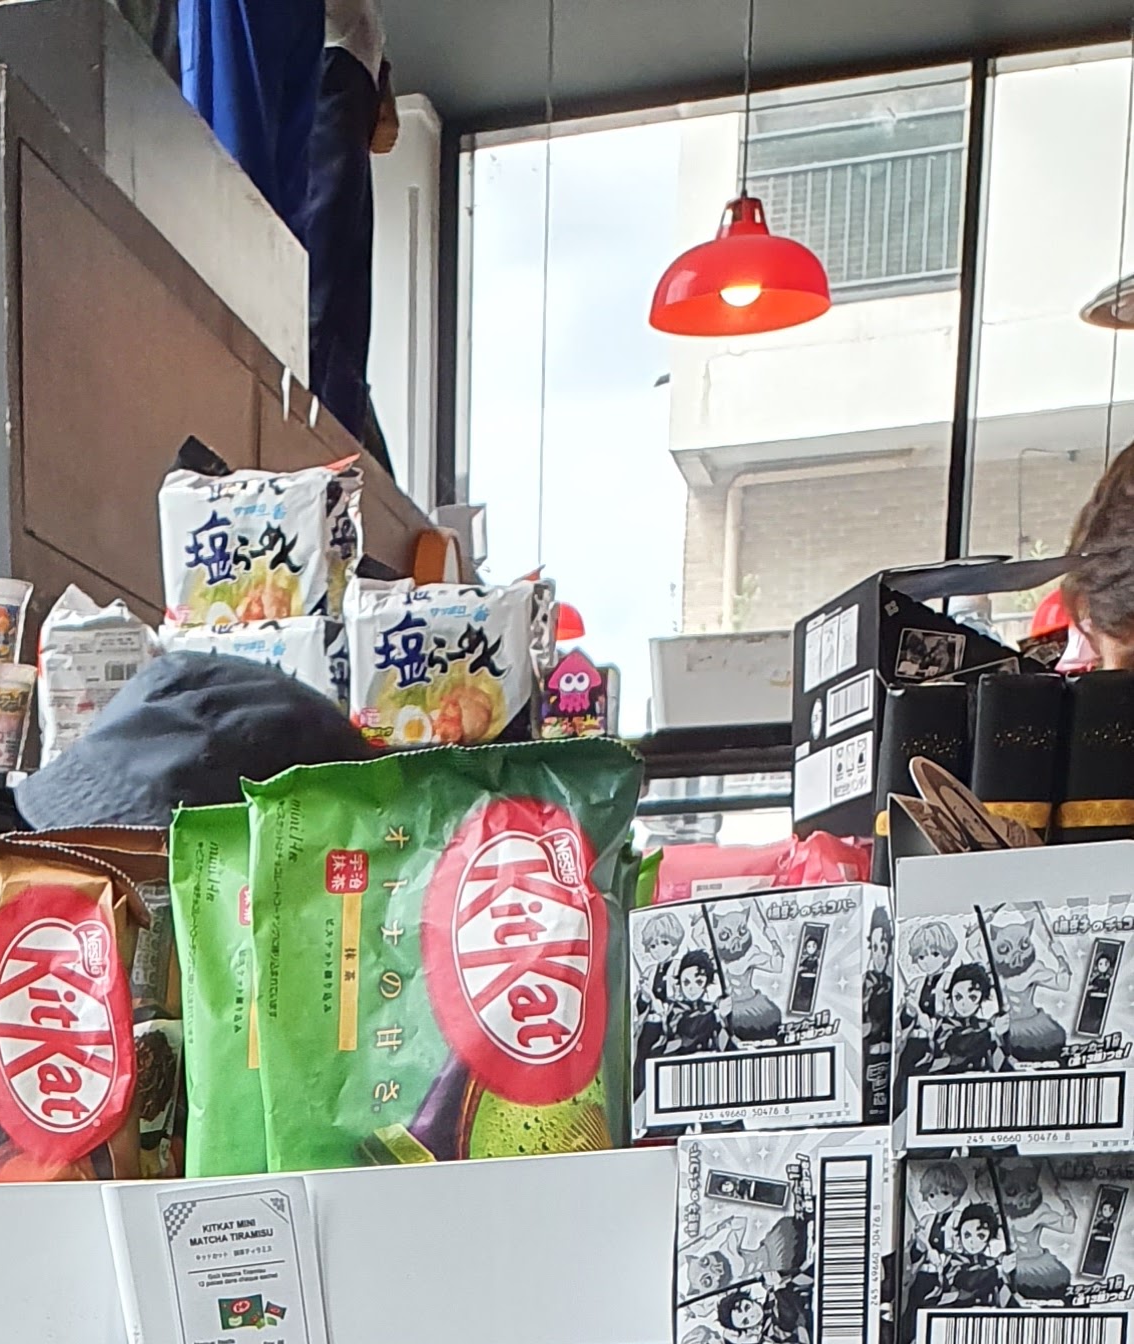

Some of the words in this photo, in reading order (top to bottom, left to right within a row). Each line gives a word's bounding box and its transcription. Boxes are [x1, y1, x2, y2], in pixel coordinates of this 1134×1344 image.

[330, 854, 347, 891] 抹茶
[349, 853, 364, 890] 宇治
[554, 836, 579, 885] Nestlé
[86, 928, 103, 976] Nestlé
[457, 859, 590, 1049] KitKat
[699, 1112, 716, 1121] 245
[752, 1107, 779, 1116] 50476
[785, 1106, 790, 1114] 8
[967, 1135, 984, 1144] 245
[990, 1134, 1021, 1143] 49660
[1028, 1133, 1059, 1142] 50476
[1064, 1132, 1071, 1141] 8
[190, 1235, 228, 1246] MATCHA
[230, 1229, 274, 1241] TIRAMISU
[202, 1221, 234, 1233] KITKAT
[237, 1219, 256, 1229] MINI
[871, 1258, 880, 1286] 49660
